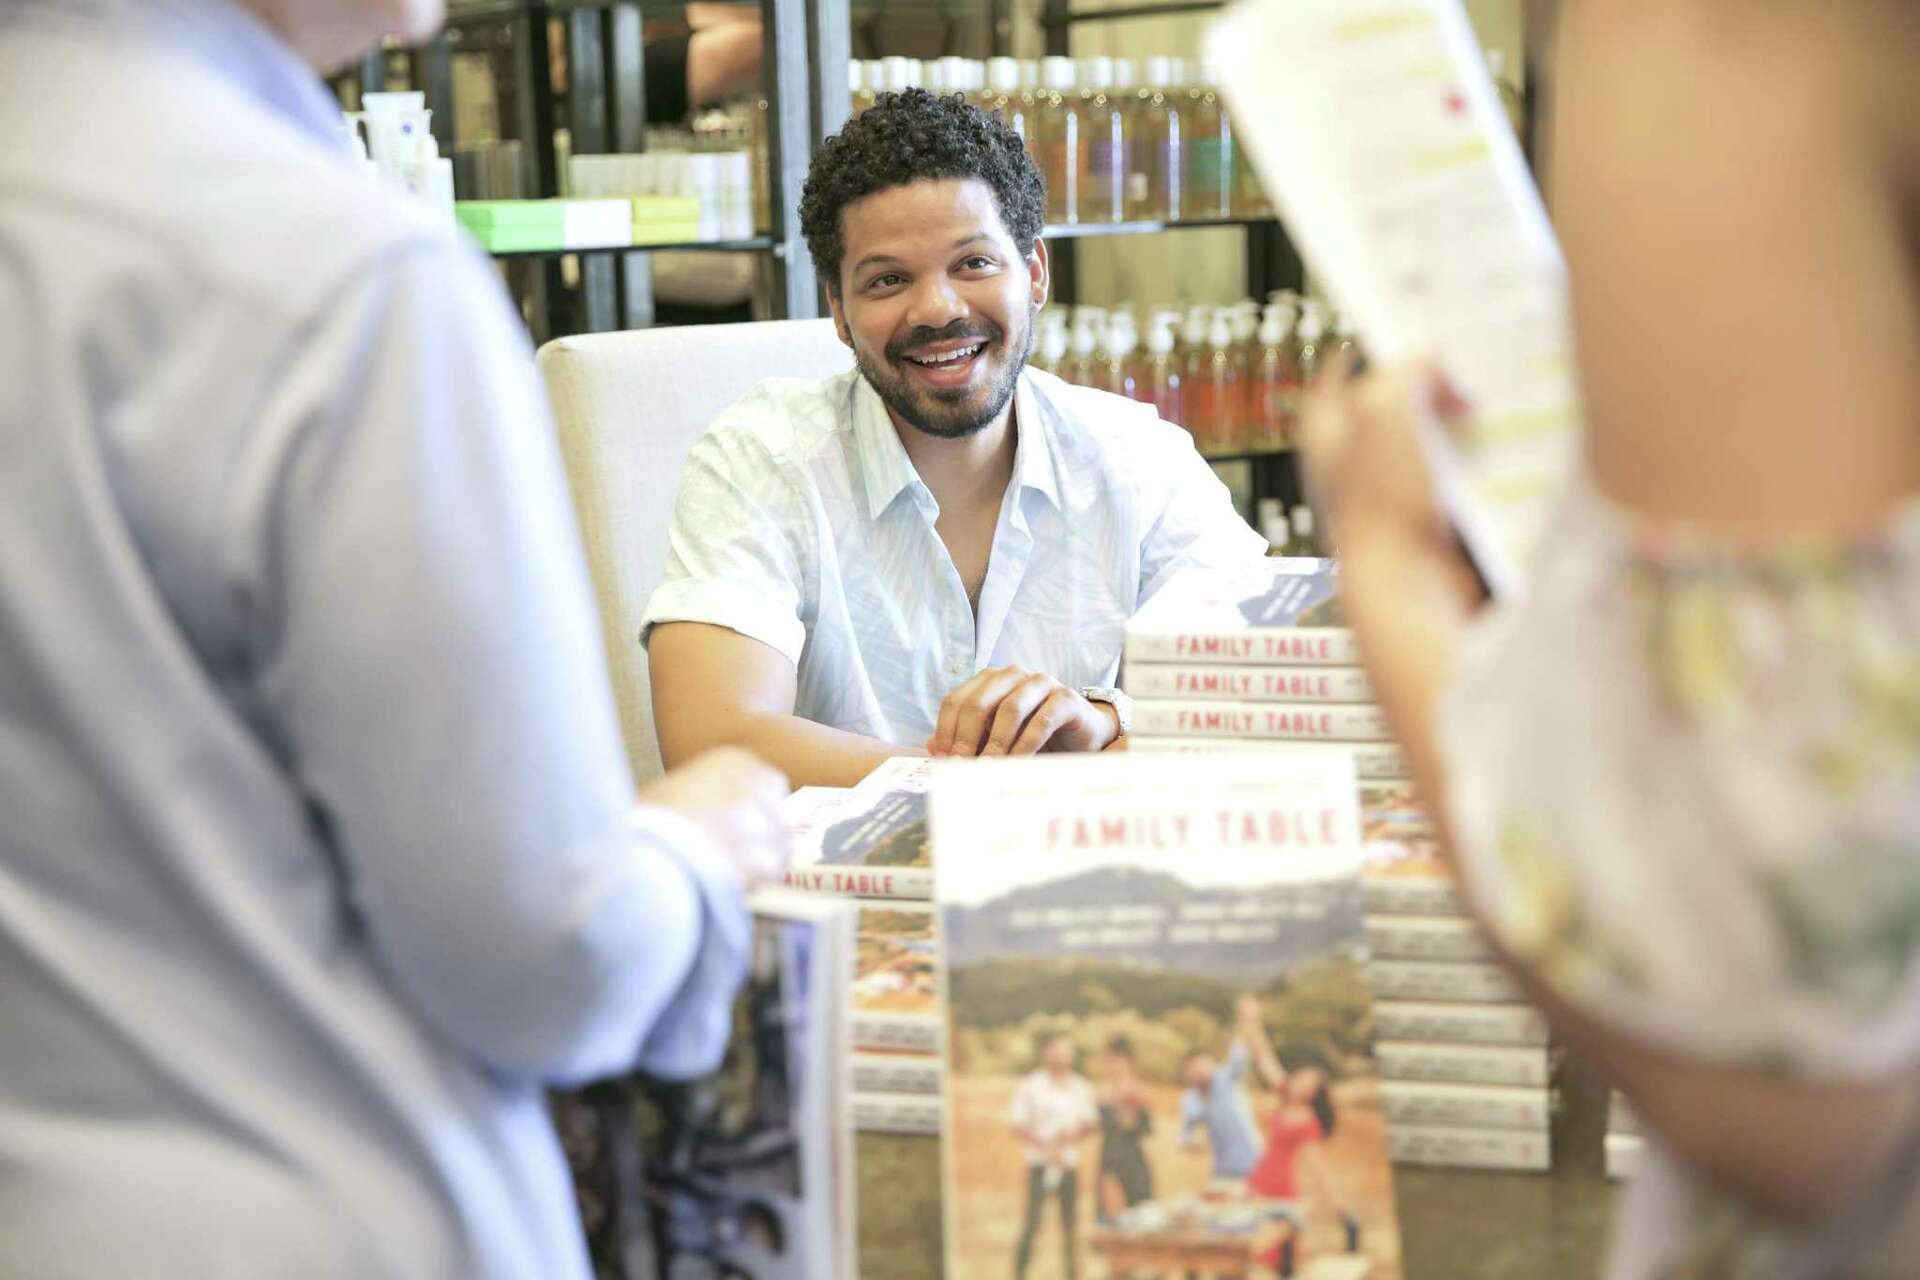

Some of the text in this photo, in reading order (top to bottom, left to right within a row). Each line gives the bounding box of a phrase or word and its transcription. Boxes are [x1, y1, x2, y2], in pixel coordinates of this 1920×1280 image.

[1176, 637, 1252, 657] FAMILY
[1264, 638, 1331, 660] TABLE
[1175, 674, 1251, 694] FAMILY
[1263, 675, 1331, 697] TABLE
[1177, 711, 1253, 732] FAMILY
[1266, 713, 1333, 735] TABLE
[1046, 815, 1191, 849] FAMILY
[1217, 808, 1340, 846] TABLE
[833, 873, 895, 894] TABLE
